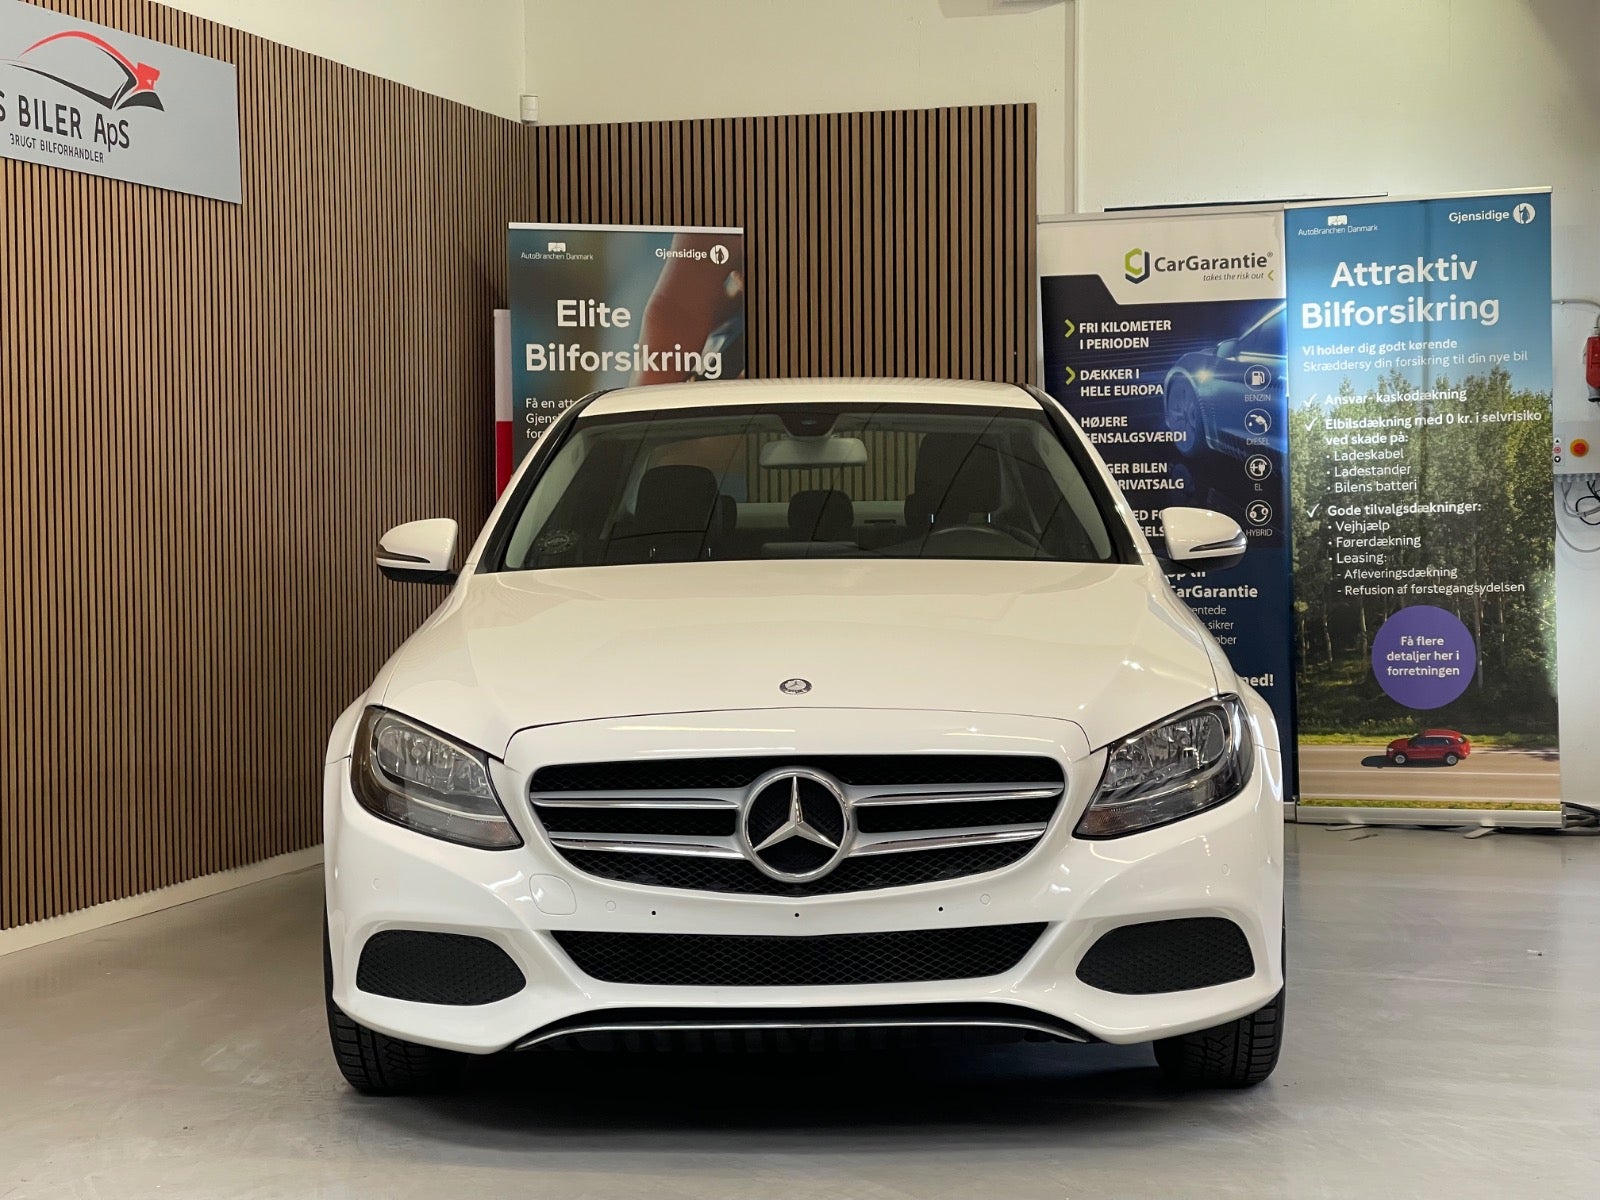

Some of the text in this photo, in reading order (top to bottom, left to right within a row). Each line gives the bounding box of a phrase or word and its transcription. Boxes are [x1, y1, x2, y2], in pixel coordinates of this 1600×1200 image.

[19, 95, 82, 139] BILER
[94, 113, 130, 152] ApS
[40, 140, 104, 163] BILFORHANDLER
[1449, 210, 1510, 223] Gjensidige
[1298, 224, 1378, 236] AutoBranchen Danmark
[521, 252, 594, 261] AutoBranchen Danmark
[655, 248, 707, 261] Gjensidige
[1203, 272, 1264, 281] takes the risk out
[1331, 254, 1478, 288] Attraktiv
[557, 298, 631, 328] Elite
[1302, 295, 1500, 329] Bilforsikring
[1079, 320, 1172, 334] FRI KILOMETER
[1080, 337, 1149, 350] I PERIODEN
[1303, 338, 1458, 356] Vi holder dig godt kørende
[526, 343, 722, 380] Bilforsikring
[1304, 350, 1528, 373] Skræddersy din forsikring til din nye bil
[1080, 368, 1140, 381] DÆKKER I
[1081, 384, 1164, 397] HELE EUROPA
[1324, 388, 1467, 405] Ansvar- kaskodækning
[526, 397, 573, 409] Få en att
[1244, 394, 1271, 402] BENZIN
[526, 412, 561, 426] Gjens
[1081, 416, 1128, 428] HØJERE
[1325, 415, 1412, 430] Elbilsdækning
[1415, 412, 1443, 425] med
[1446, 413, 1454, 425] 0
[1457, 411, 1473, 424] kr.
[1482, 410, 1542, 422] selvrisiko
[526, 429, 543, 439] for
[1326, 431, 1409, 446] ved skade på:
[1246, 437, 1270, 446] DIESEL
[1334, 448, 1404, 461] Ladeskabel
[1106, 463, 1167, 474] GER BILEN
[1334, 464, 1411, 477] Ladestander
[1117, 478, 1185, 490] RIVATSALG
[1254, 483, 1263, 492] EL
[1335, 479, 1417, 493] Bilens batteri
[1133, 510, 1149, 521] ED
[1327, 501, 1482, 517] Gode tilvalgsdækninger:
[1246, 528, 1273, 537] HYBRID
[1336, 521, 1390, 533] Vejhjælp
[1336, 535, 1422, 549] Førerdækning
[1336, 551, 1387, 564] Leasing:
[1344, 566, 1458, 580] Afleveringsdækning
[1345, 580, 1525, 598] Refusion af førstegangsydelsen
[1191, 605, 1227, 615] entede
[1208, 620, 1234, 630] sikrer
[1401, 635, 1444, 646] Få flere
[1386, 650, 1431, 663] detaljer
[1434, 650, 1453, 661] her
[1387, 665, 1460, 678] forretningen
